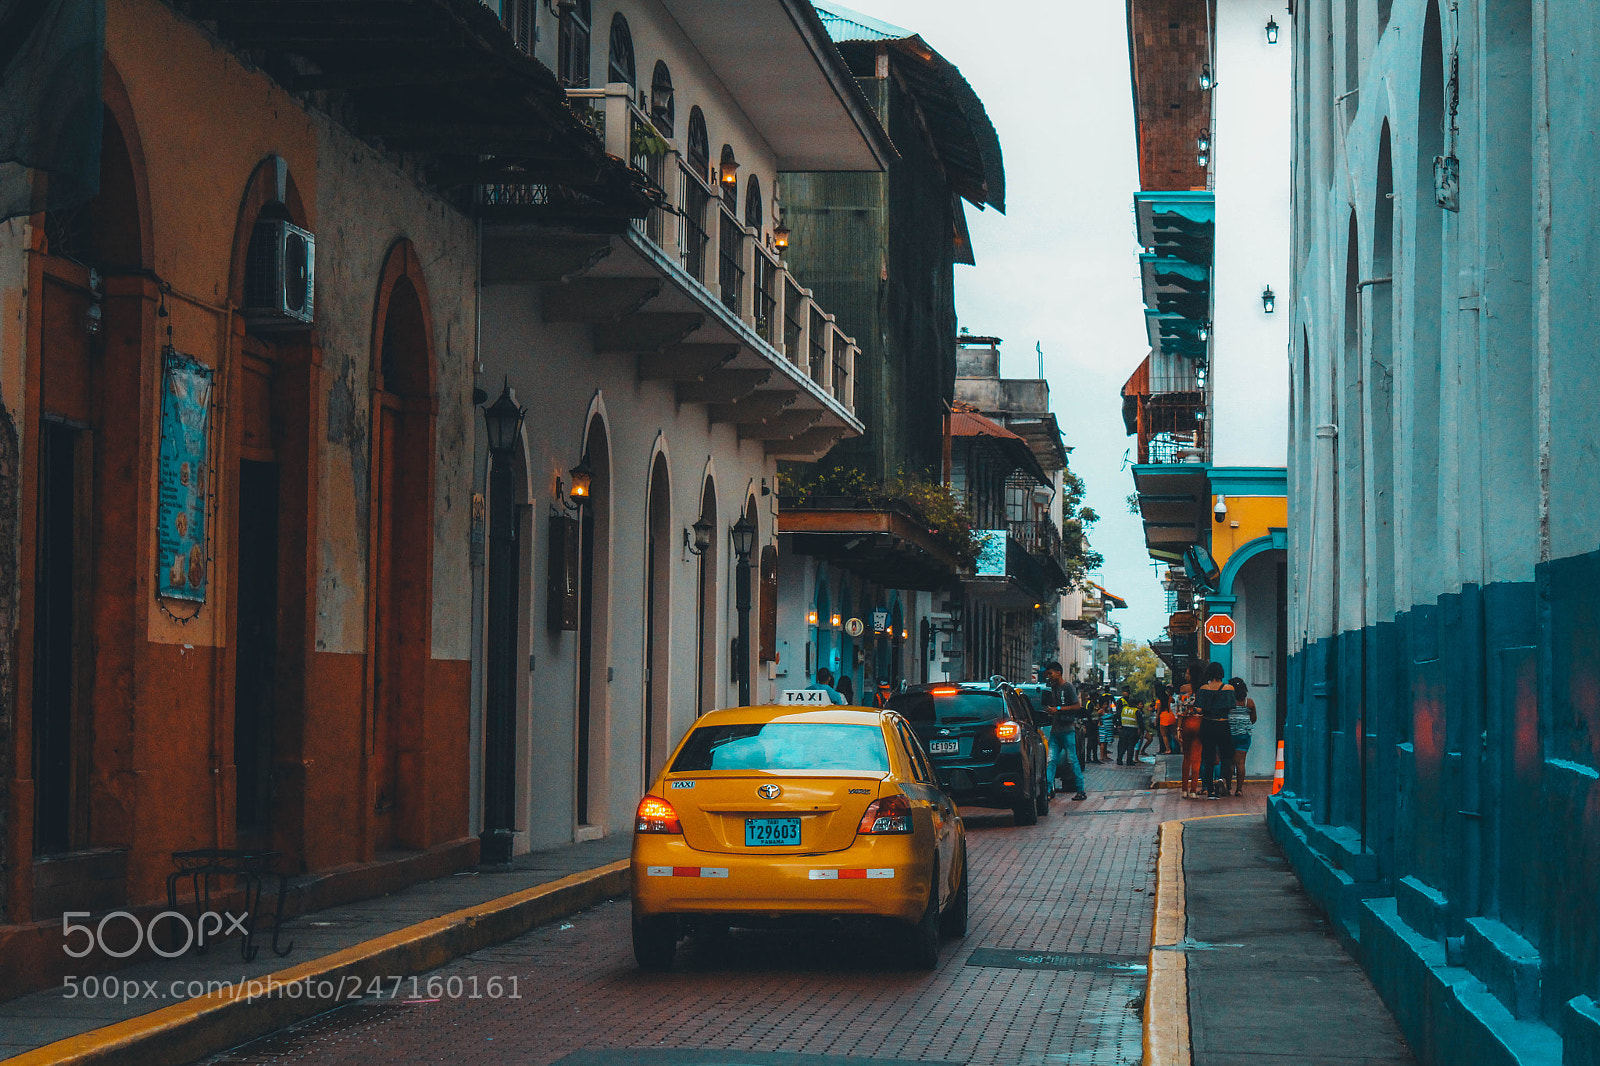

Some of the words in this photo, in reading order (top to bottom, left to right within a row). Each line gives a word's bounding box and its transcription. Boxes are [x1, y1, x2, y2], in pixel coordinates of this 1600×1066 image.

[1208, 625, 1233, 634] ALTO
[786, 692, 822, 701] TAXI
[931, 742, 957, 751] CE1057
[673, 781, 695, 789] TAXI
[749, 824, 797, 840] T29603
